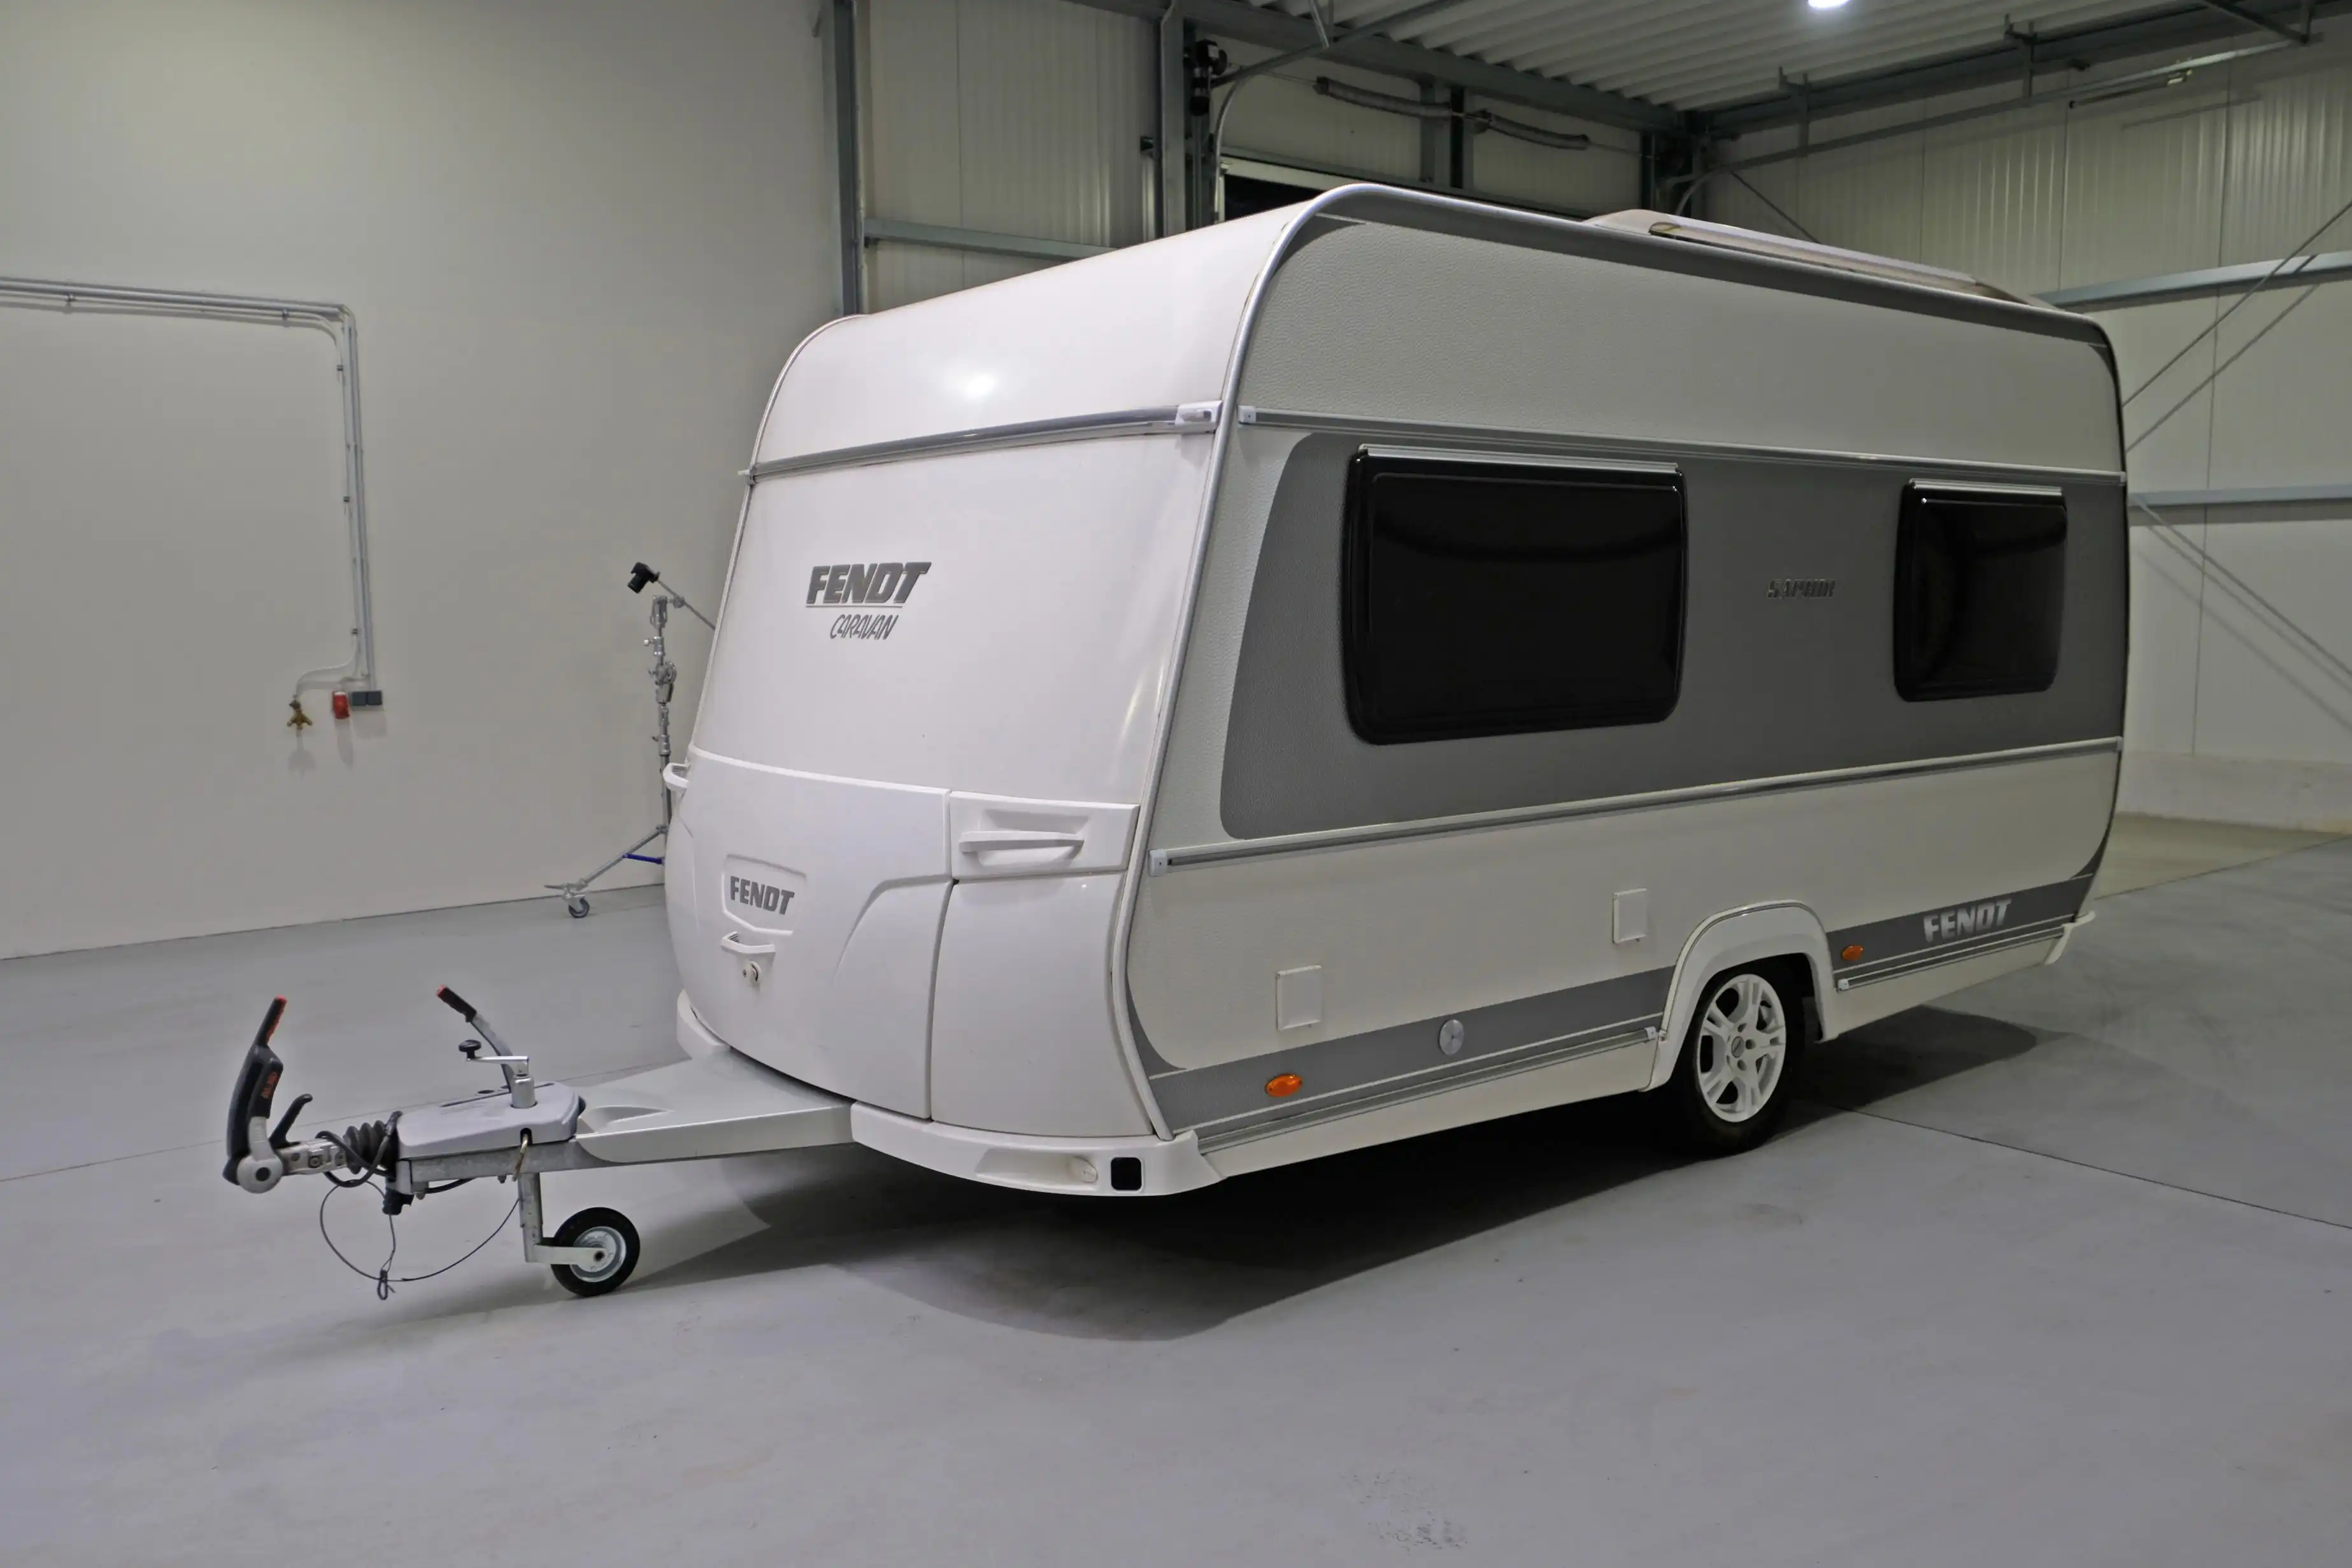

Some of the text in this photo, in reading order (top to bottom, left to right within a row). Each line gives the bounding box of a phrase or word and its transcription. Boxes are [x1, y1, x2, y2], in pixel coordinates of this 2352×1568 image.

[806, 562, 932, 604] FENDT
[830, 614, 899, 639] CARAVAN
[730, 876, 795, 915] FENDT
[1923, 899, 2011, 943] FENDT
